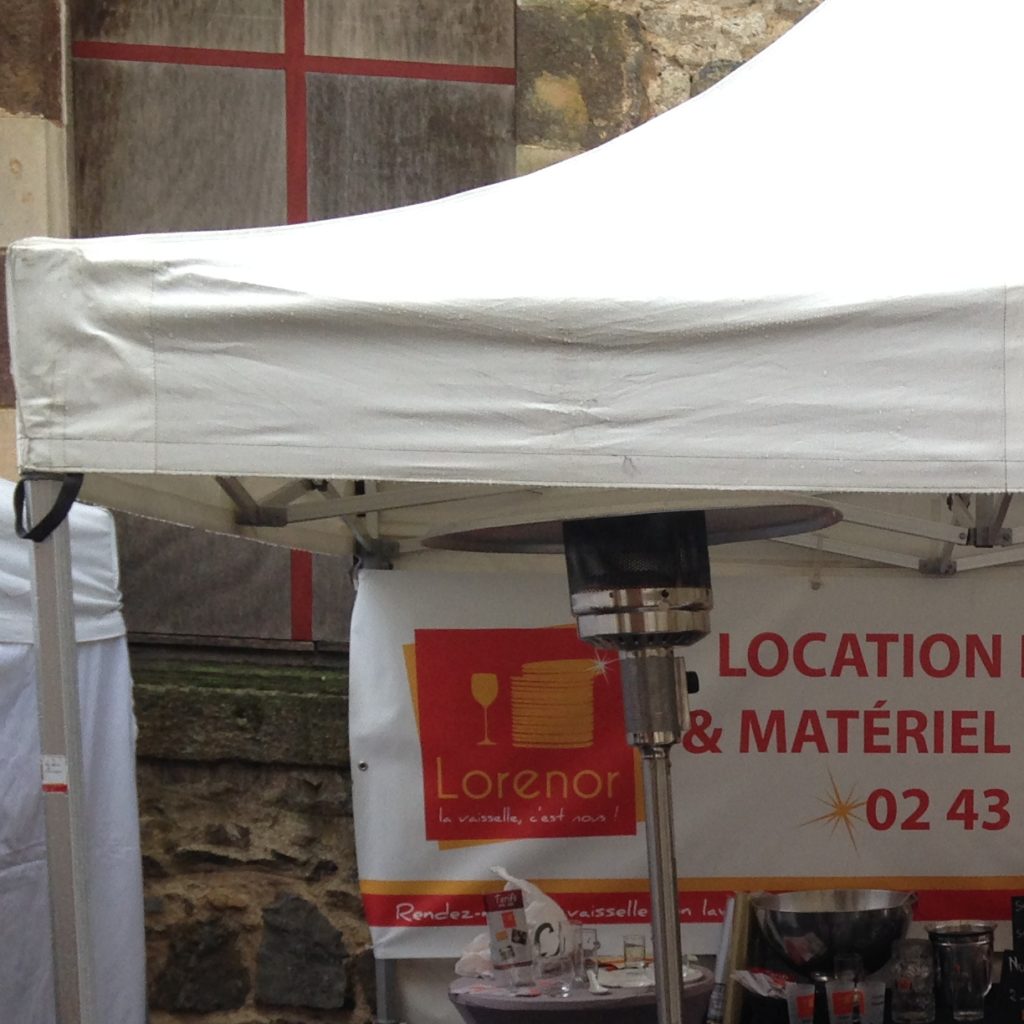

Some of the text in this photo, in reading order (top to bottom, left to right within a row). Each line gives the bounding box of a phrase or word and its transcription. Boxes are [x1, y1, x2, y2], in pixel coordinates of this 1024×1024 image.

[719, 632, 1002, 679] LOCATION
[682, 709, 723, 754] &
[739, 700, 1011, 755] MATÉRIEL
[436, 757, 620, 800] Lorenor
[439, 806, 452, 822] la
[530, 806, 565, 823] c'est
[572, 814, 607, 823] nous
[866, 788, 930, 831] 02
[946, 788, 1011, 831] 43
[395, 902, 487, 921] Rendez-
[567, 899, 647, 918] vaisselle
